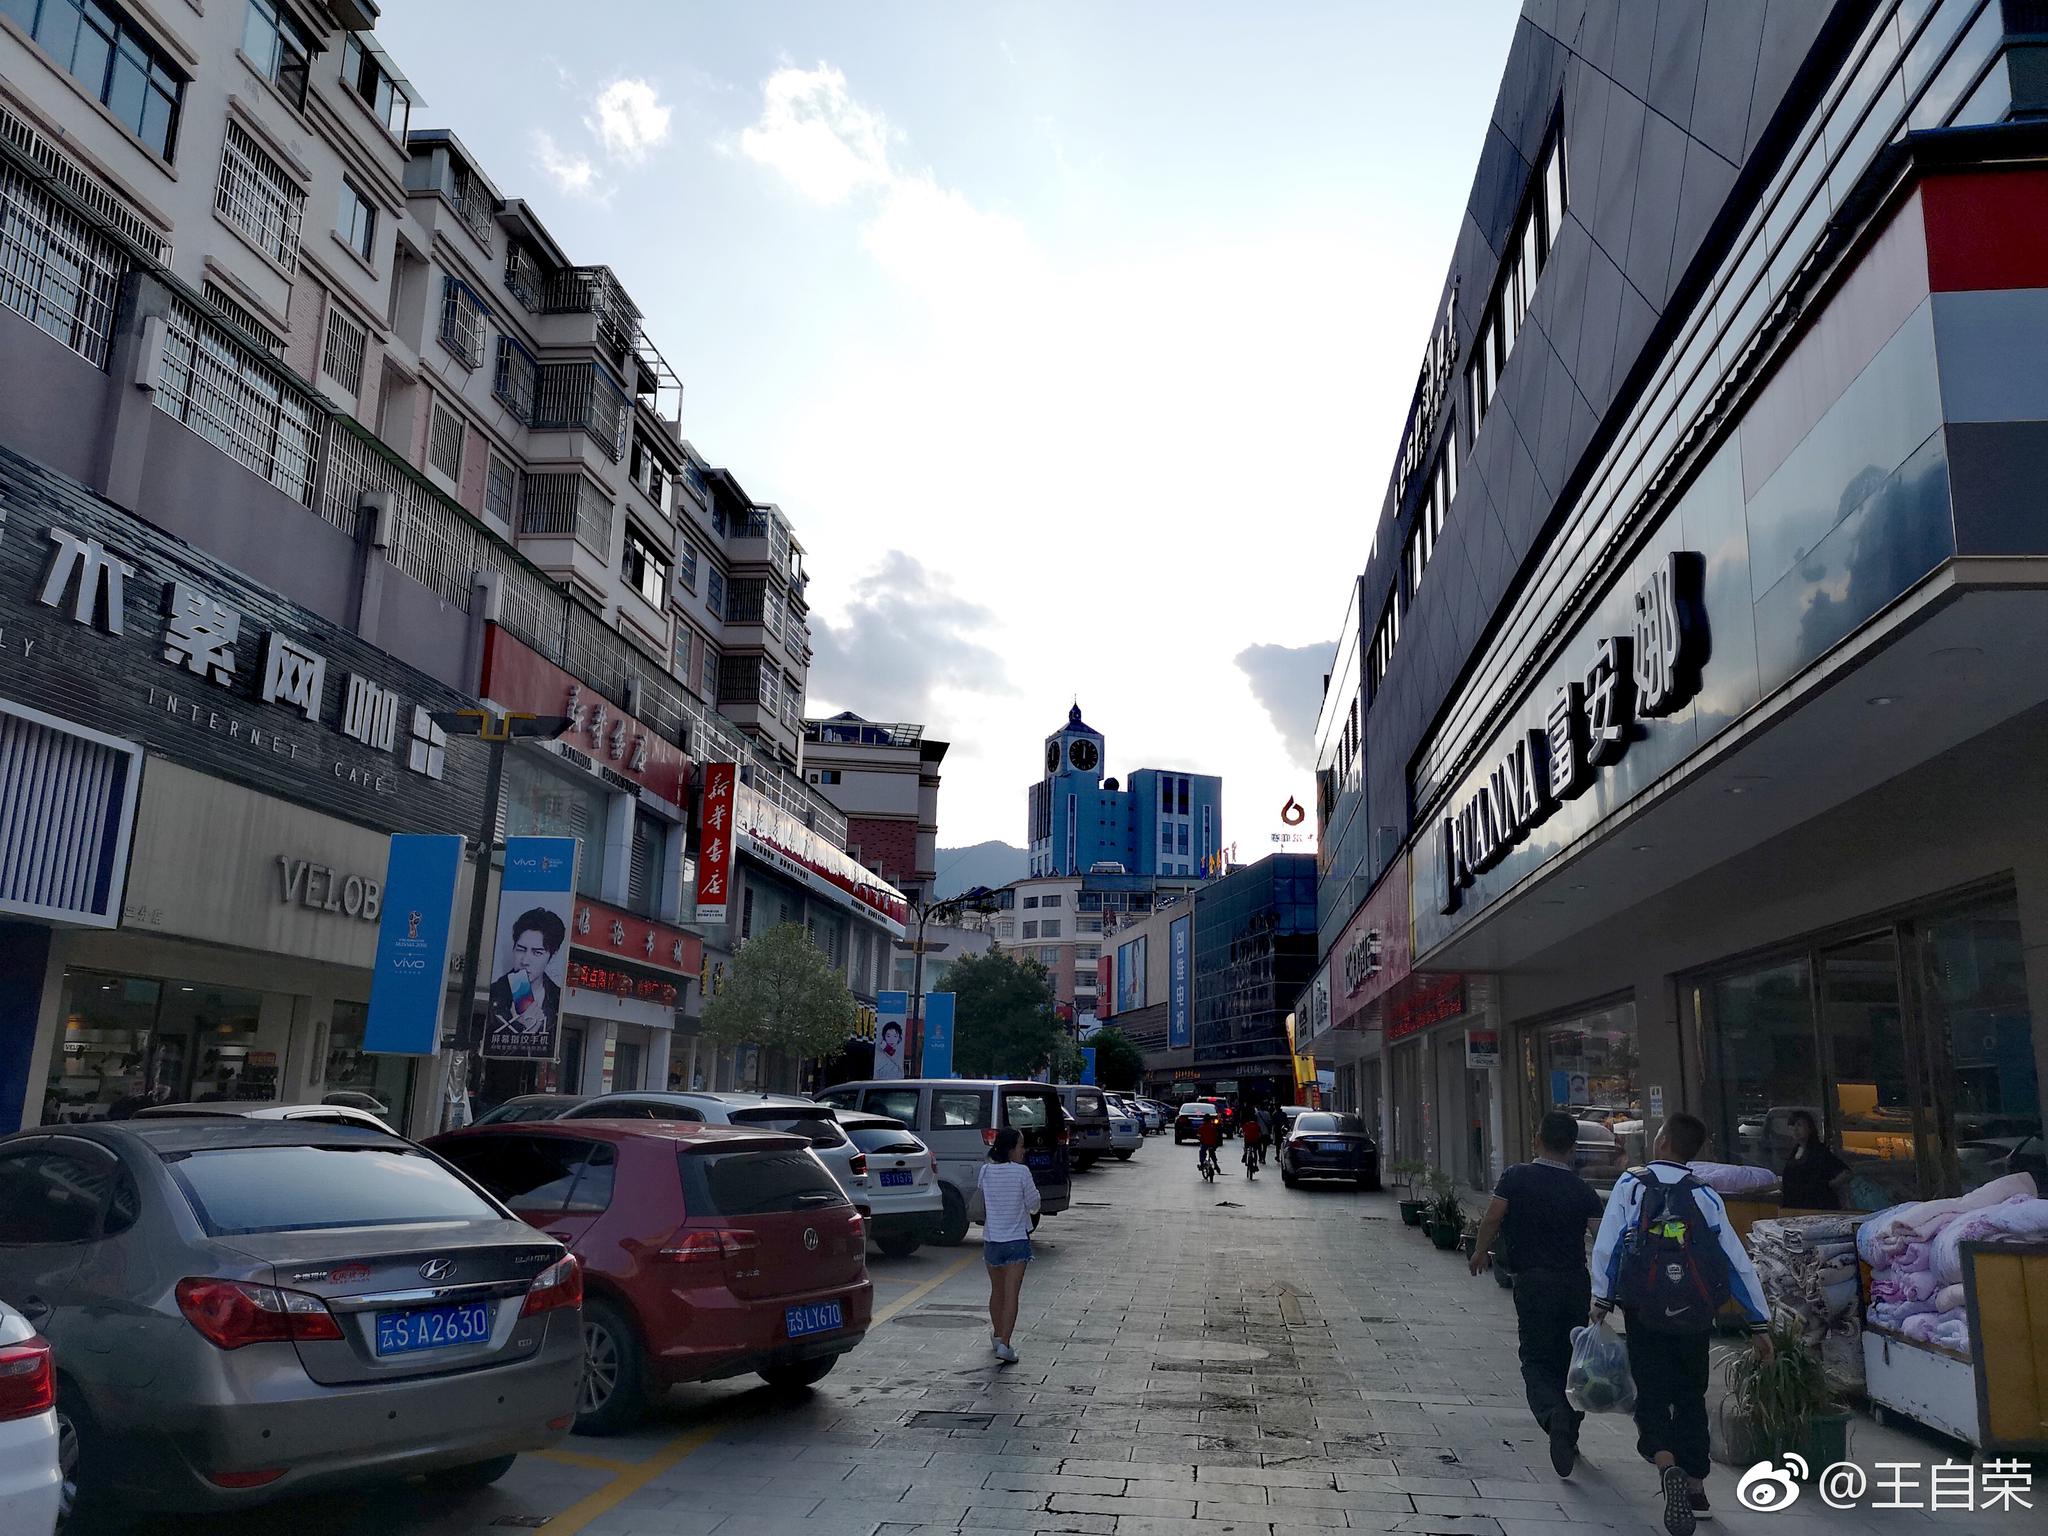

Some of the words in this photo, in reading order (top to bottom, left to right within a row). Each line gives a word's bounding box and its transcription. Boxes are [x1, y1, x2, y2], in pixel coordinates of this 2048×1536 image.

[0, 507, 399, 753] 木累网咖
[149, 687, 299, 760] INTERNET
[1451, 729, 1540, 887] FUANNA
[1545, 553, 1679, 801] 富安娜
[513, 857, 537, 866] vivo
[393, 957, 425, 969] vivo
[493, 1014, 550, 1034] X21
